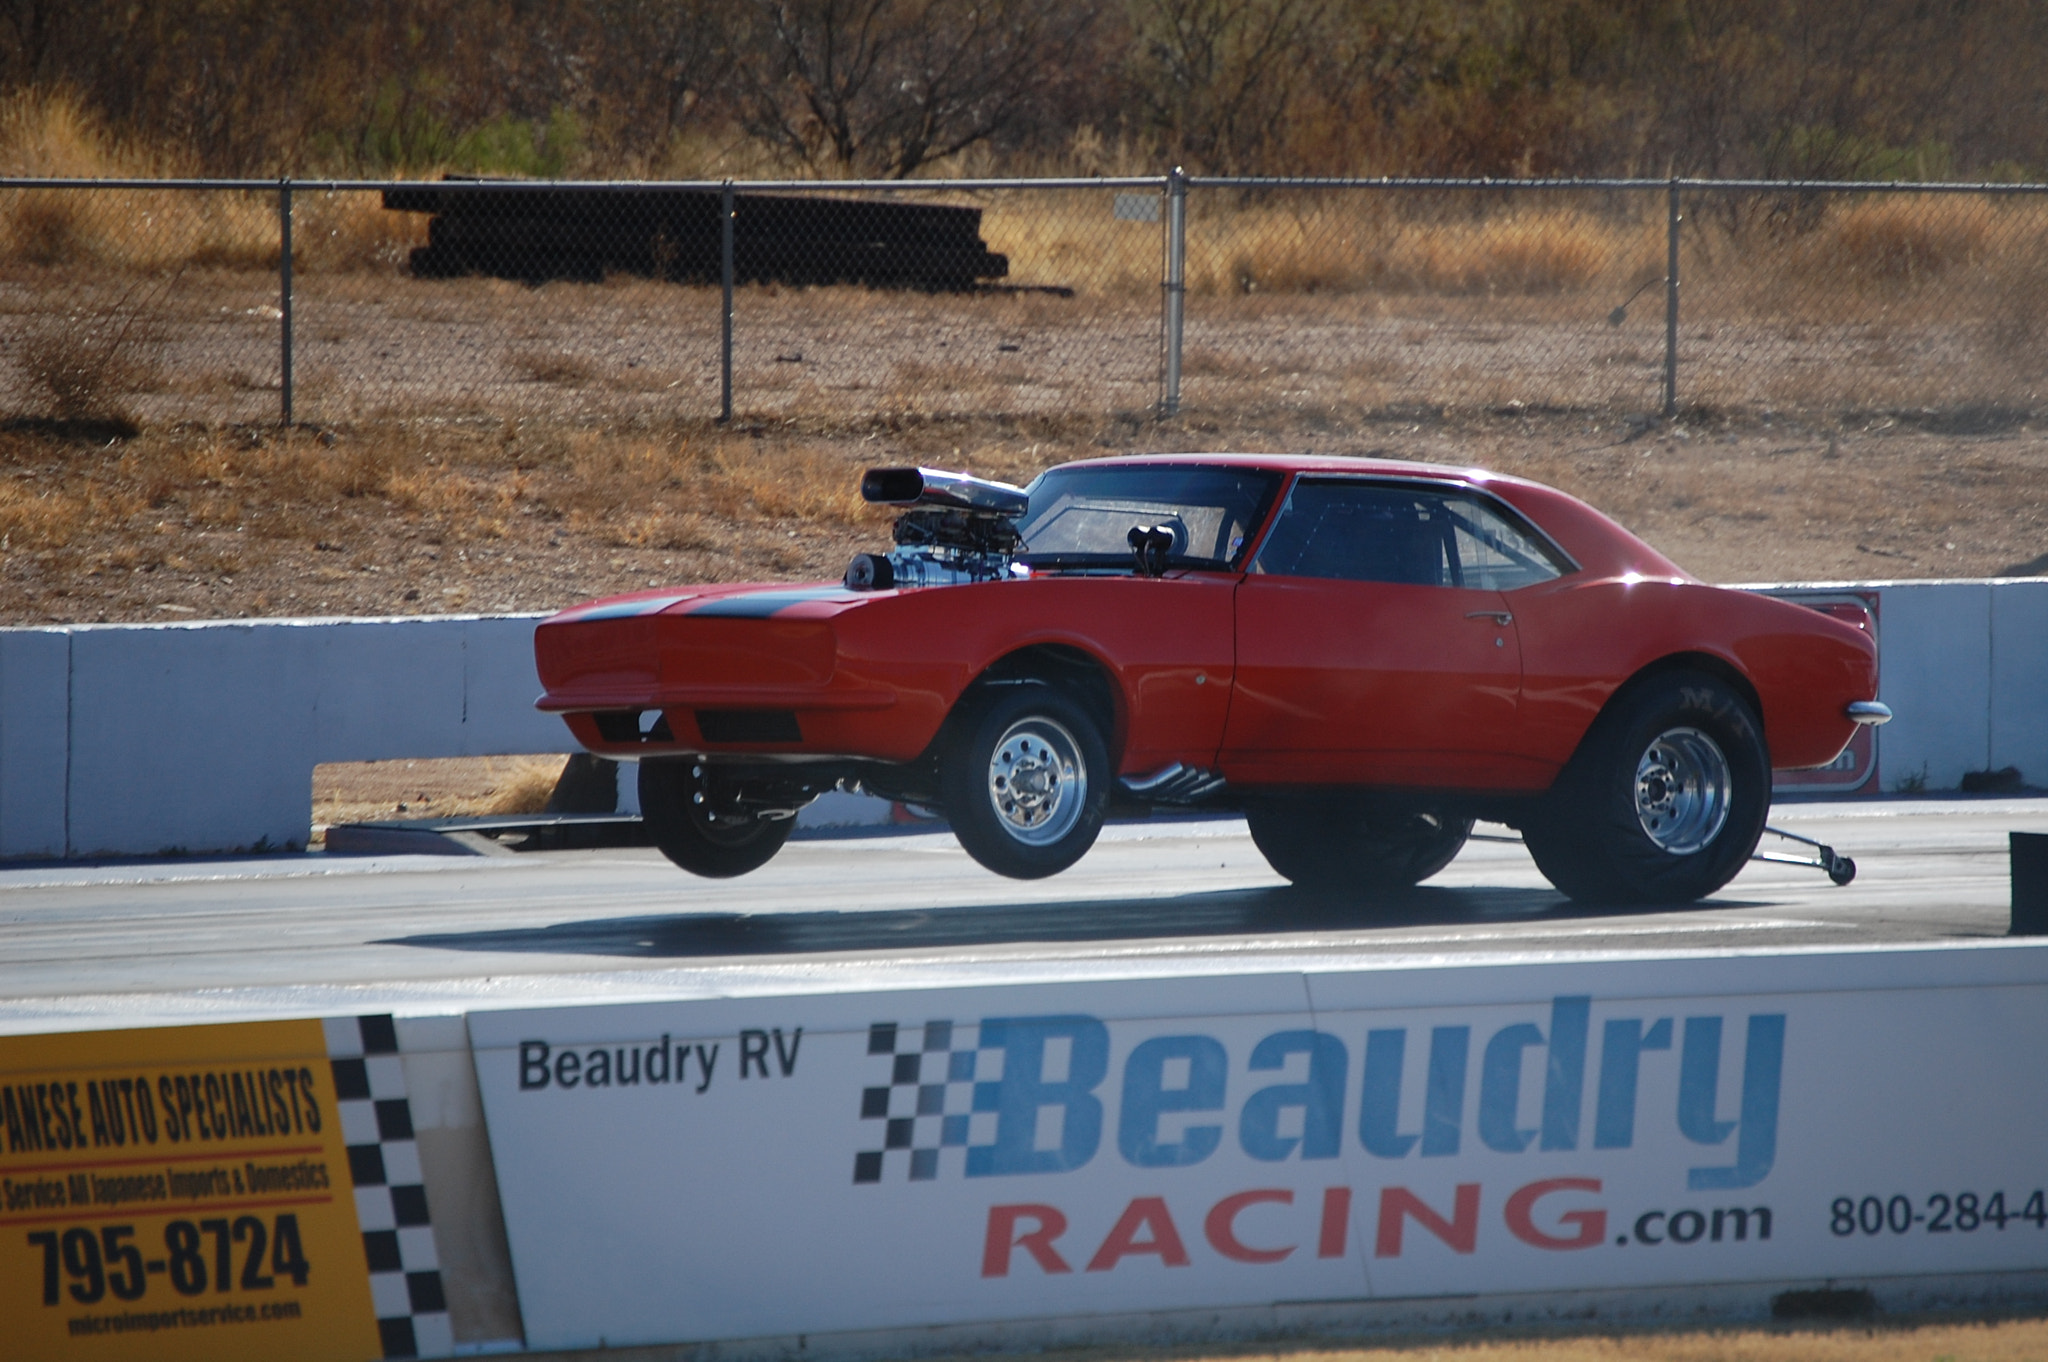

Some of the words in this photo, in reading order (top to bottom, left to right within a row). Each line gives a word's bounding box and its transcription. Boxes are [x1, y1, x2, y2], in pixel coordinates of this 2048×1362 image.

[519, 1033, 719, 1095] Beaudry
[739, 1027, 803, 1079] RV
[964, 996, 1787, 1190] Beaudry
[87, 1076, 158, 1147] AUTO
[159, 1066, 323, 1143] SPECIALISTS
[4, 1177, 67, 1211] Service
[167, 1168, 231, 1200] Imports
[245, 1162, 331, 1194] Domestics
[1830, 1190, 2048, 1237] 800-284-4
[27, 1213, 311, 1307] 795-8724
[68, 1301, 302, 1338] microimportservice.com
